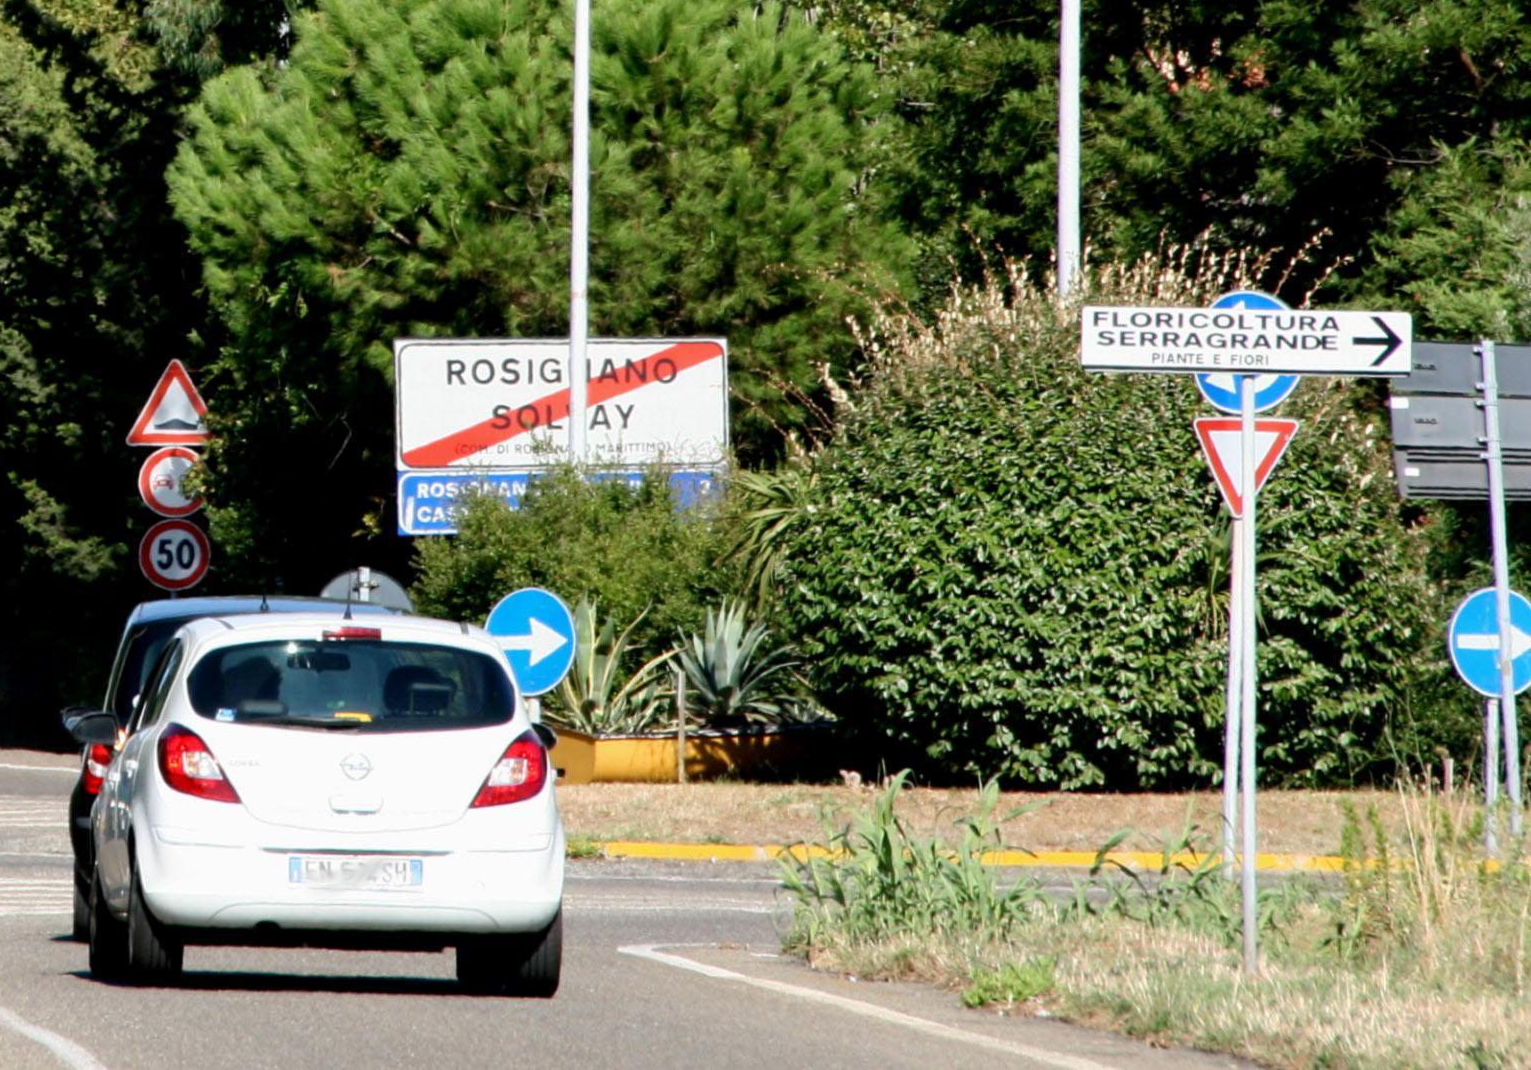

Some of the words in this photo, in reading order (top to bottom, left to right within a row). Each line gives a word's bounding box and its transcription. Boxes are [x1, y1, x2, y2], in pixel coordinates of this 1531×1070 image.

[1092, 311, 1341, 332] FLORICOLTURA
[1096, 330, 1339, 351] SERRAGRANDE
[1151, 352, 1205, 365] PIANTE
[1212, 353, 1222, 365] E
[1229, 354, 1270, 366] FIORI
[445, 357, 679, 386] ROSIGANO
[490, 403, 636, 431] SOLAY
[497, 443, 510, 455] DI
[514, 442, 591, 455] RONAO
[417, 481, 541, 499] ROSNAN
[157, 538, 195, 571] 50
